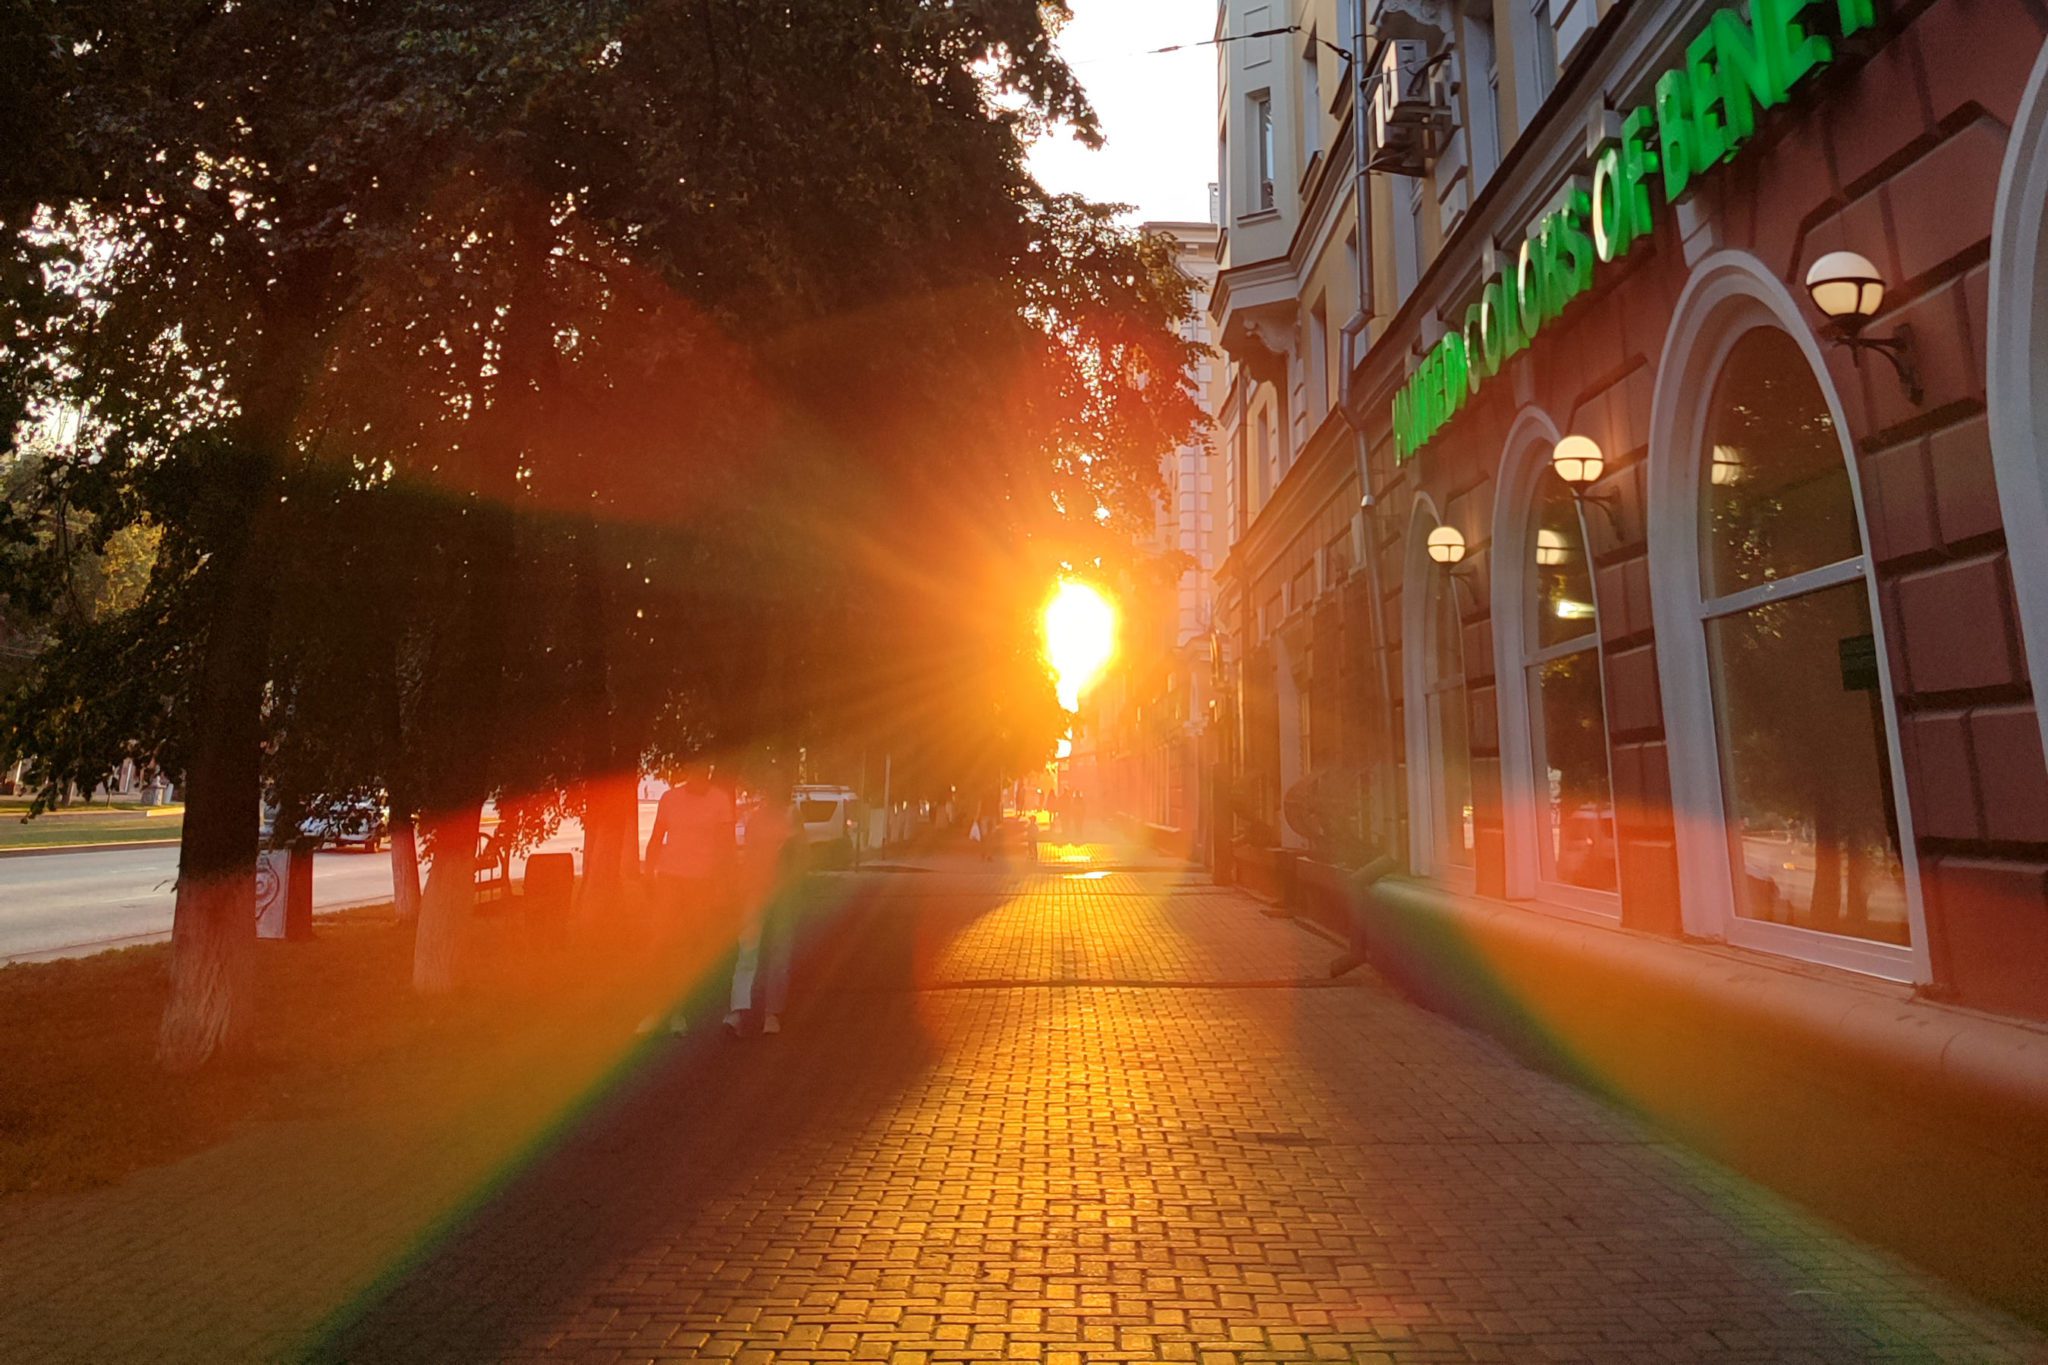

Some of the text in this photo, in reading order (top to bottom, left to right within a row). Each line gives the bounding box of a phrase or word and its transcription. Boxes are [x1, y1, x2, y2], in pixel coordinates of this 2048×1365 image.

[1464, 189, 1593, 394] COLORS
[1593, 106, 1657, 263] OF
[1655, 0, 1875, 204] BENE
